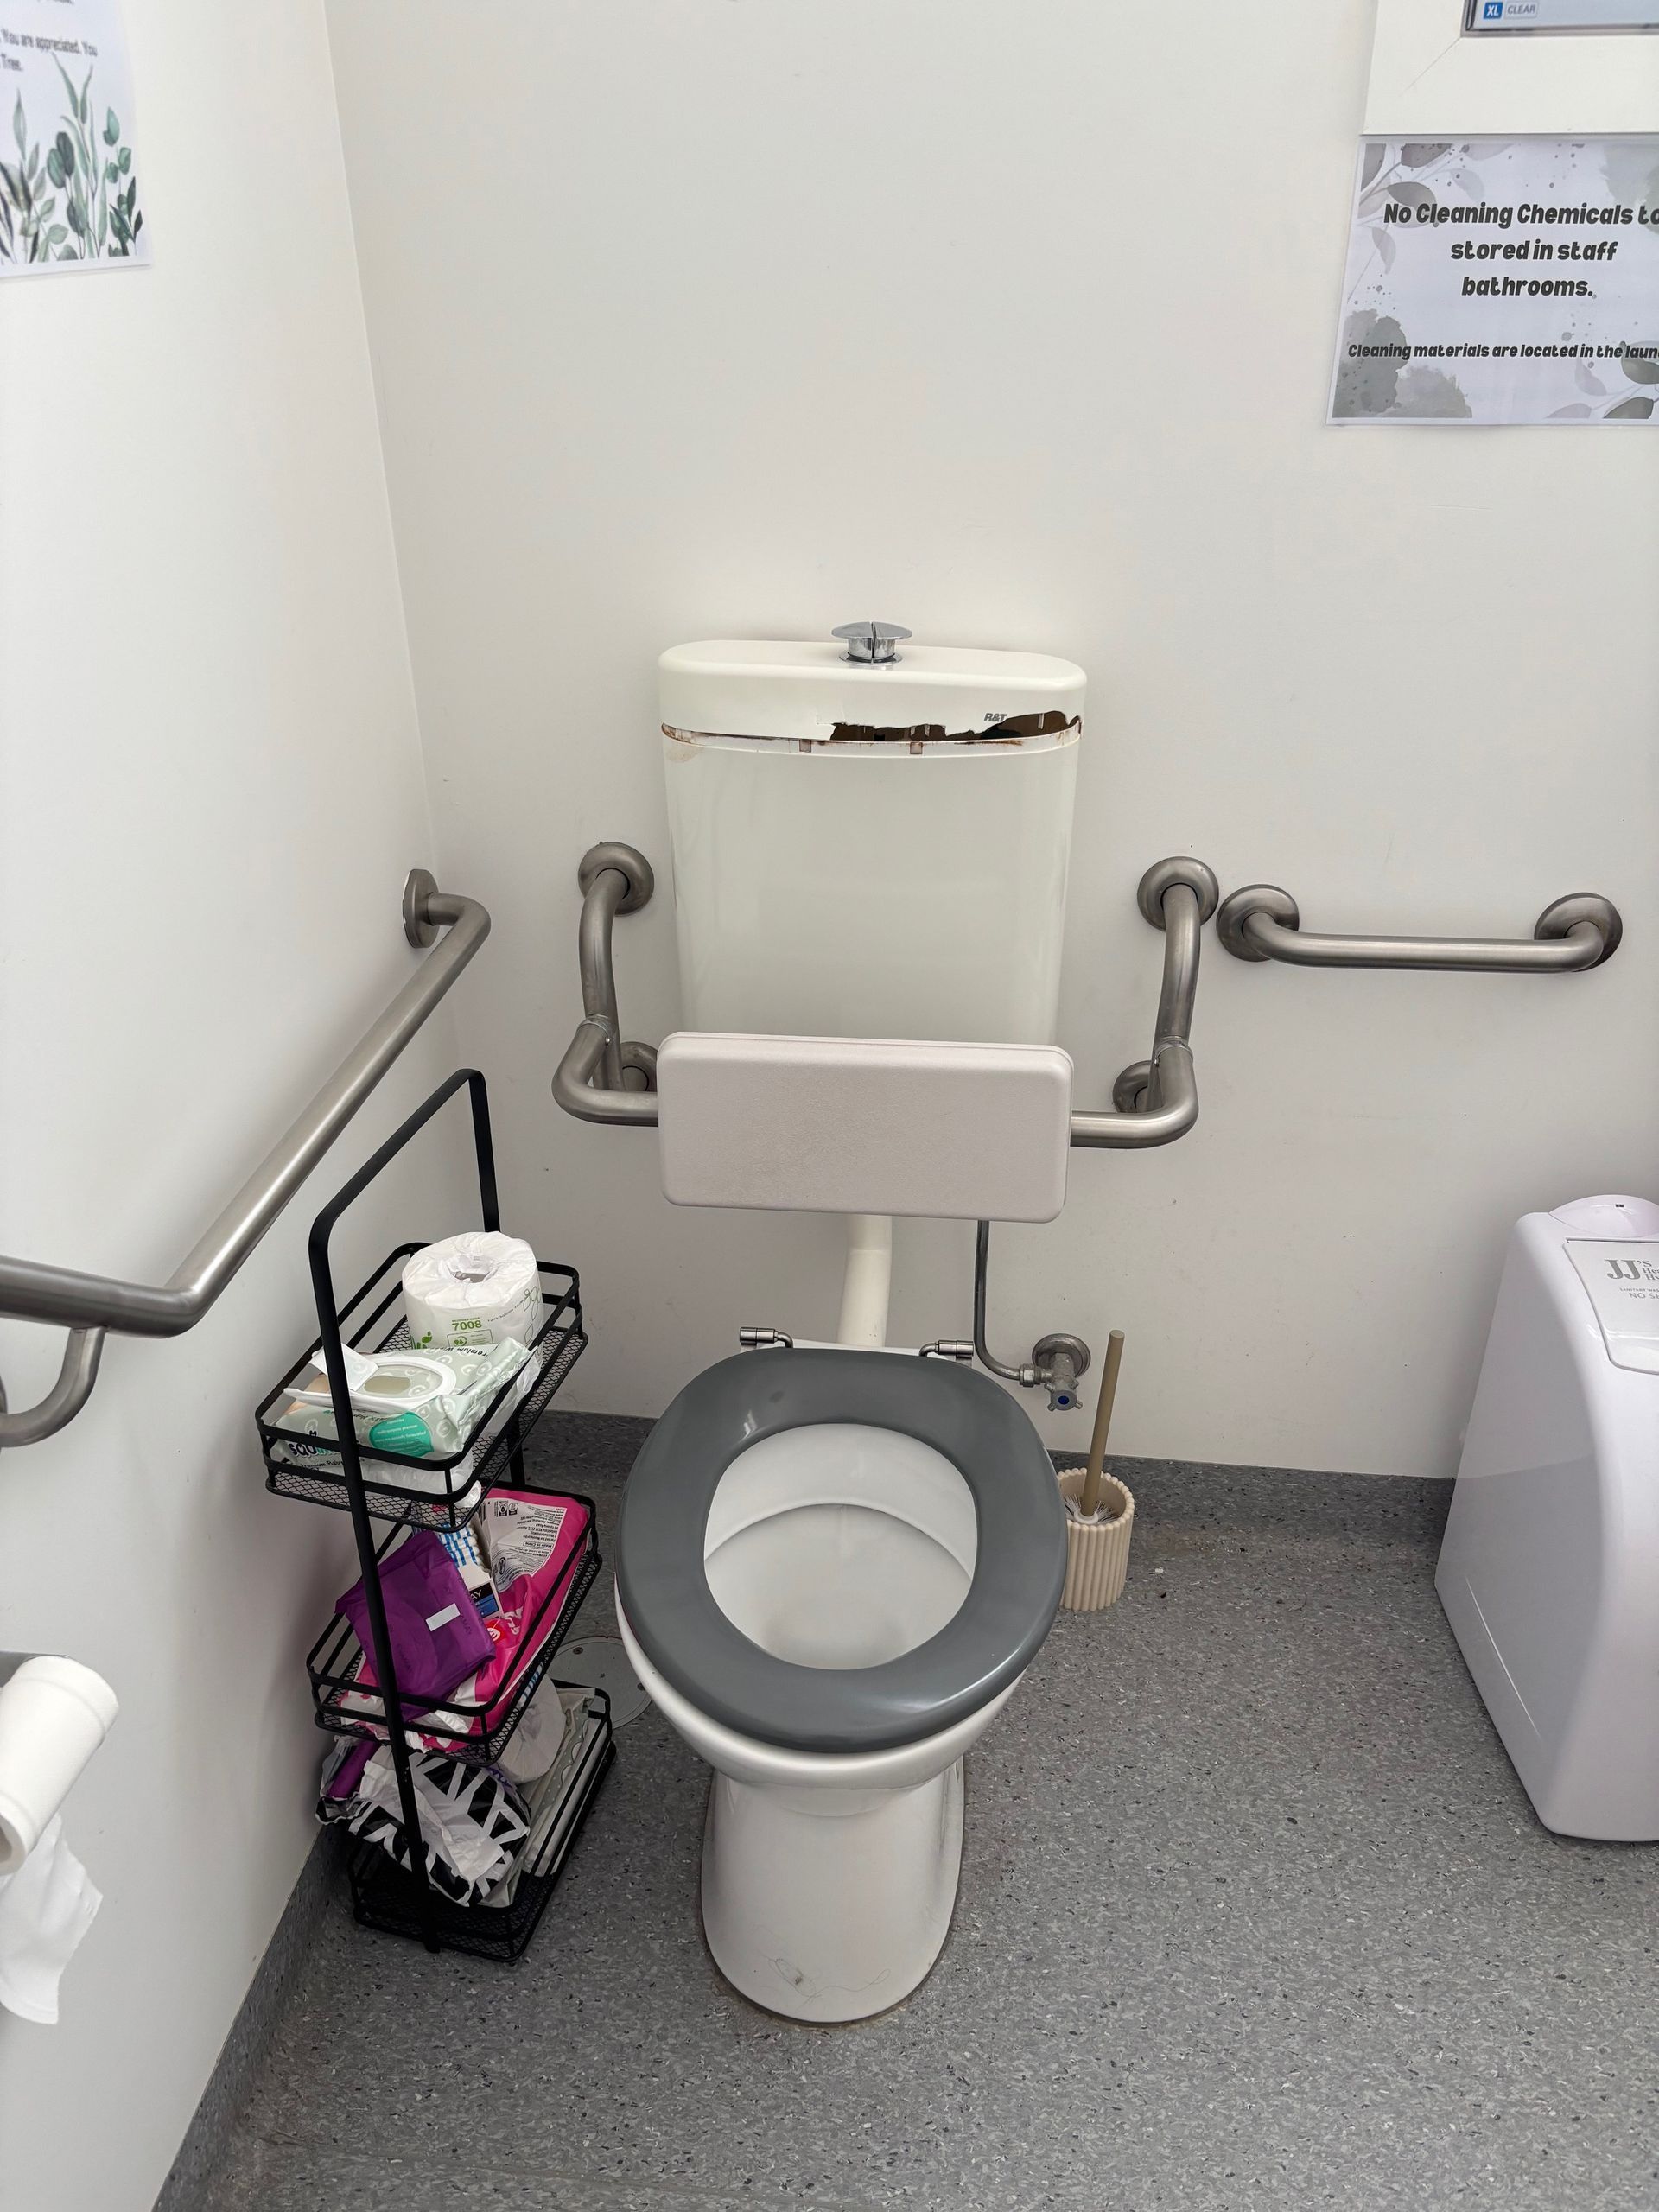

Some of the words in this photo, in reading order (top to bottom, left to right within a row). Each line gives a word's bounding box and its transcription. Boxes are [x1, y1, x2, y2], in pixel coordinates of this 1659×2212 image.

[1486, 4, 1499, 17] XL
[1507, 4, 1535, 15] CLEAR
[1383, 203, 1412, 225] No
[1415, 201, 1514, 230] Cleaning
[1517, 202, 1634, 226] Chemicals
[1451, 240, 1530, 260] stored
[1533, 238, 1554, 260] in
[1557, 241, 1618, 261] staff
[1461, 276, 1594, 296] bathrooms.
[1348, 343, 1412, 360] Cleaning
[1413, 343, 1490, 358] materials
[1492, 345, 1518, 358] are
[1520, 344, 1577, 358] located
[1580, 343, 1594, 358] in
[1596, 345, 1623, 359] the
[1625, 345, 1659, 359] laun
[984, 713, 1007, 722] R&T
[452, 1320, 482, 1331] 7008
